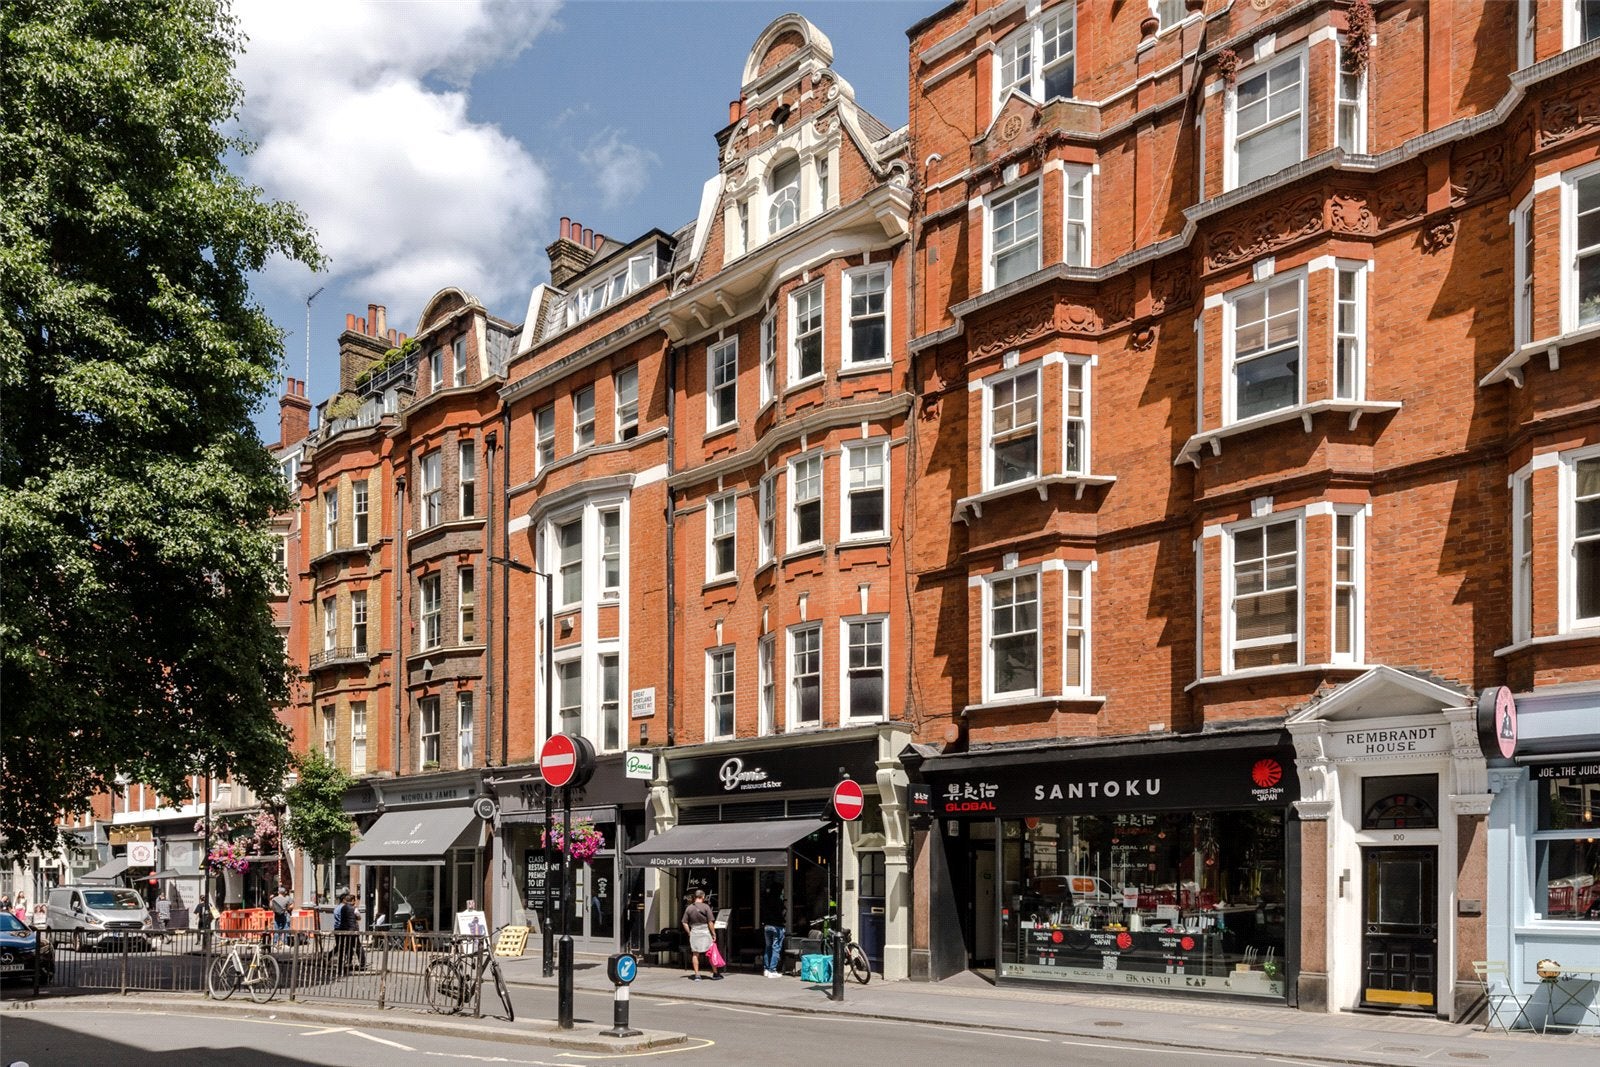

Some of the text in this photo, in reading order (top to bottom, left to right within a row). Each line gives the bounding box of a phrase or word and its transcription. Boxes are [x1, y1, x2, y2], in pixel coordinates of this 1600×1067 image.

[1346, 728, 1437, 744] REMBRANDT
[1366, 741, 1416, 753] HOUSE
[1538, 767, 1554, 777] JOE
[1560, 766, 1576, 776] THE
[1578, 764, 1600, 776] JUIC
[401, 789, 457, 801] NICHOLAS JAMES
[1034, 779, 1160, 800] SANTOKU
[1257, 793, 1278, 801] JAPAN
[945, 801, 997, 812] GLOBAL
[528, 855, 544, 863] CLASS
[657, 858, 667, 866] Day
[667, 858, 683, 866] Dining
[688, 857, 705, 865] Coffee
[711, 856, 739, 865] Restaurant
[746, 856, 756, 864] Bar
[528, 879, 544, 887] TO LET
[1131, 974, 1171, 985] KASUMI
